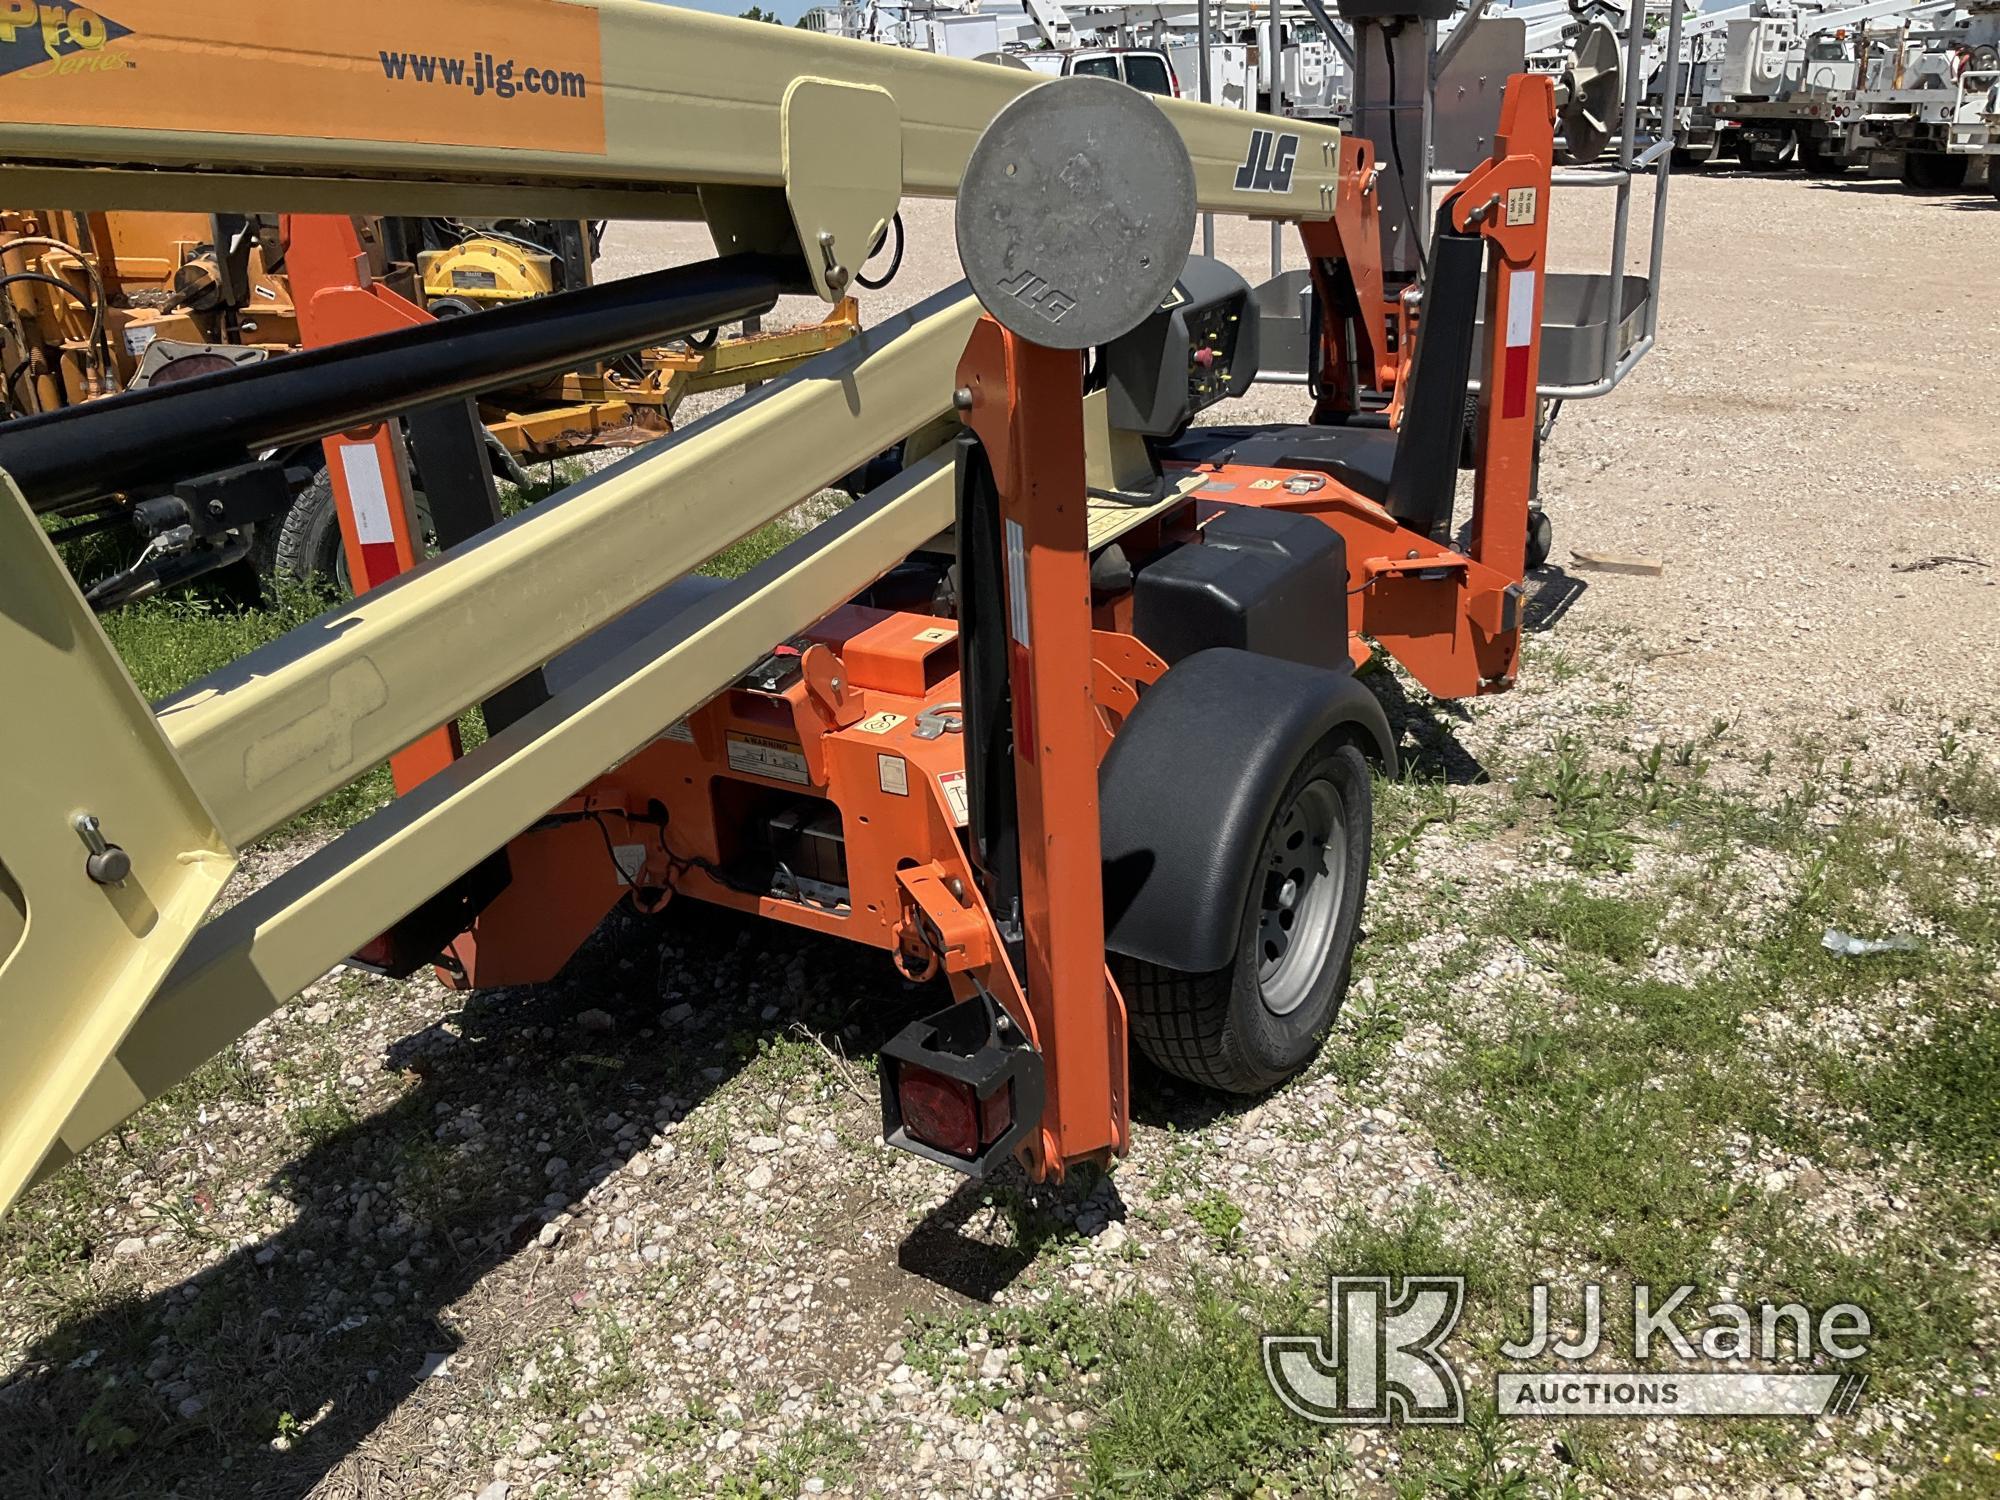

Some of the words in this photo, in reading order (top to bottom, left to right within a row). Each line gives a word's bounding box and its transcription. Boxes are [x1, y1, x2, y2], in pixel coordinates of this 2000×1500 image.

[19, 38, 128, 79] Series
[379, 51, 586, 98] www.jlg.com
[1233, 128, 1300, 194] JLG
[996, 270, 1077, 323] JLG
